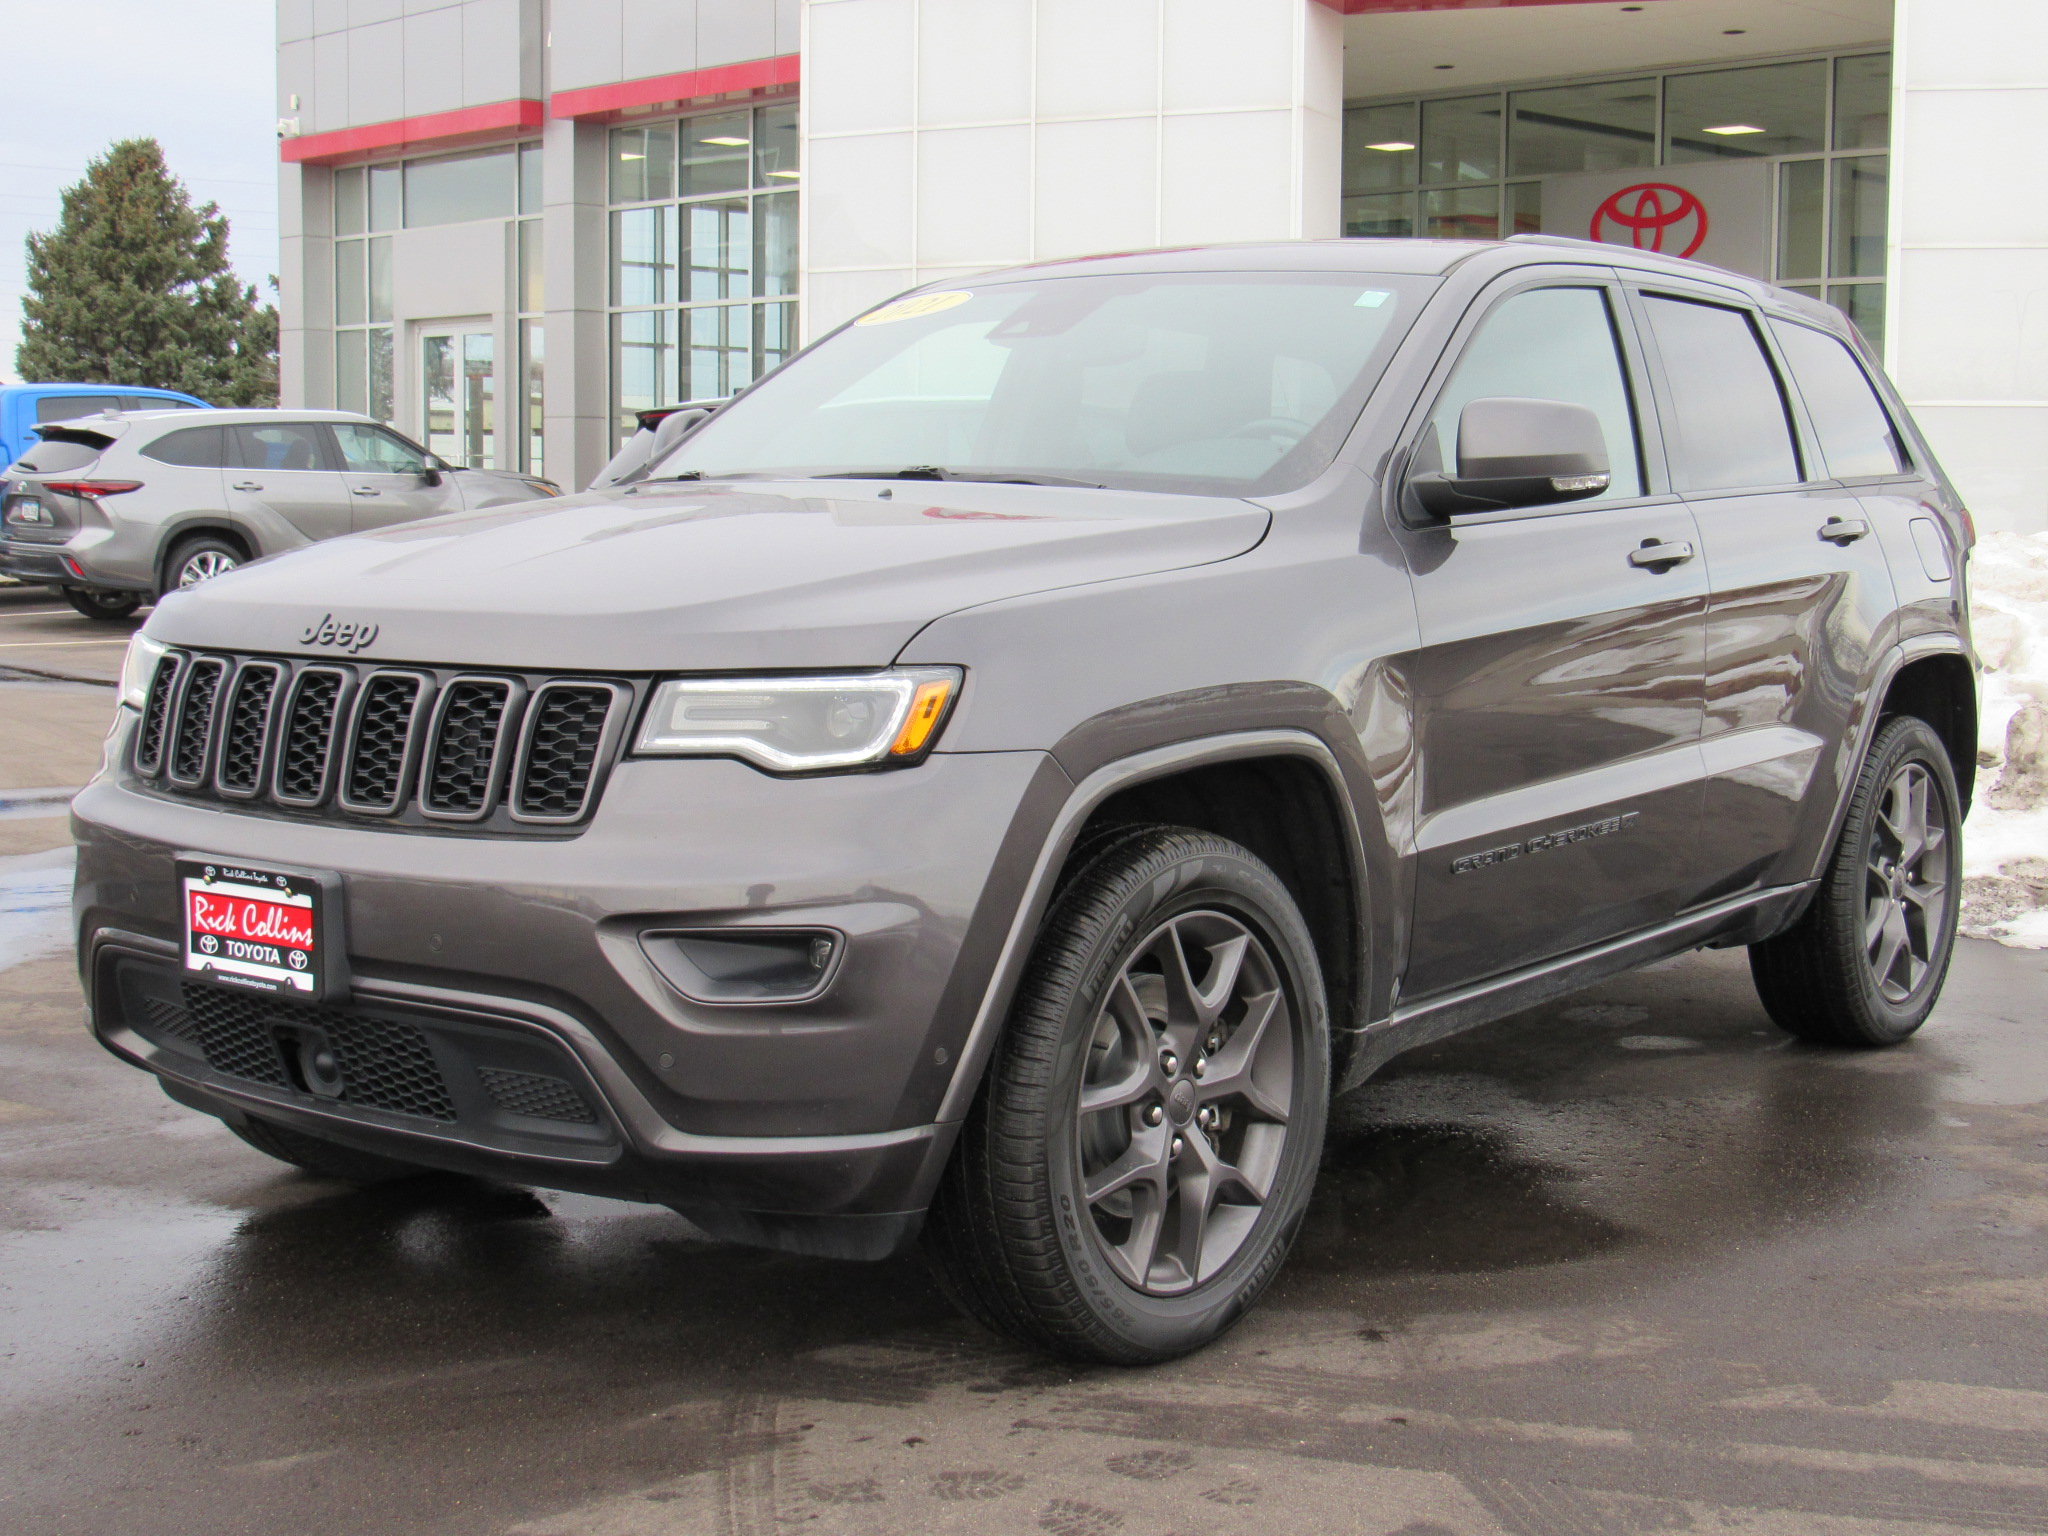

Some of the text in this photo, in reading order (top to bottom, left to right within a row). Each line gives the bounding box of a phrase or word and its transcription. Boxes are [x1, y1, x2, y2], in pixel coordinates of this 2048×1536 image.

[300, 613, 379, 654] Jeep
[194, 896, 313, 946] Rick Collins
[226, 940, 281, 964] TOYOTA
